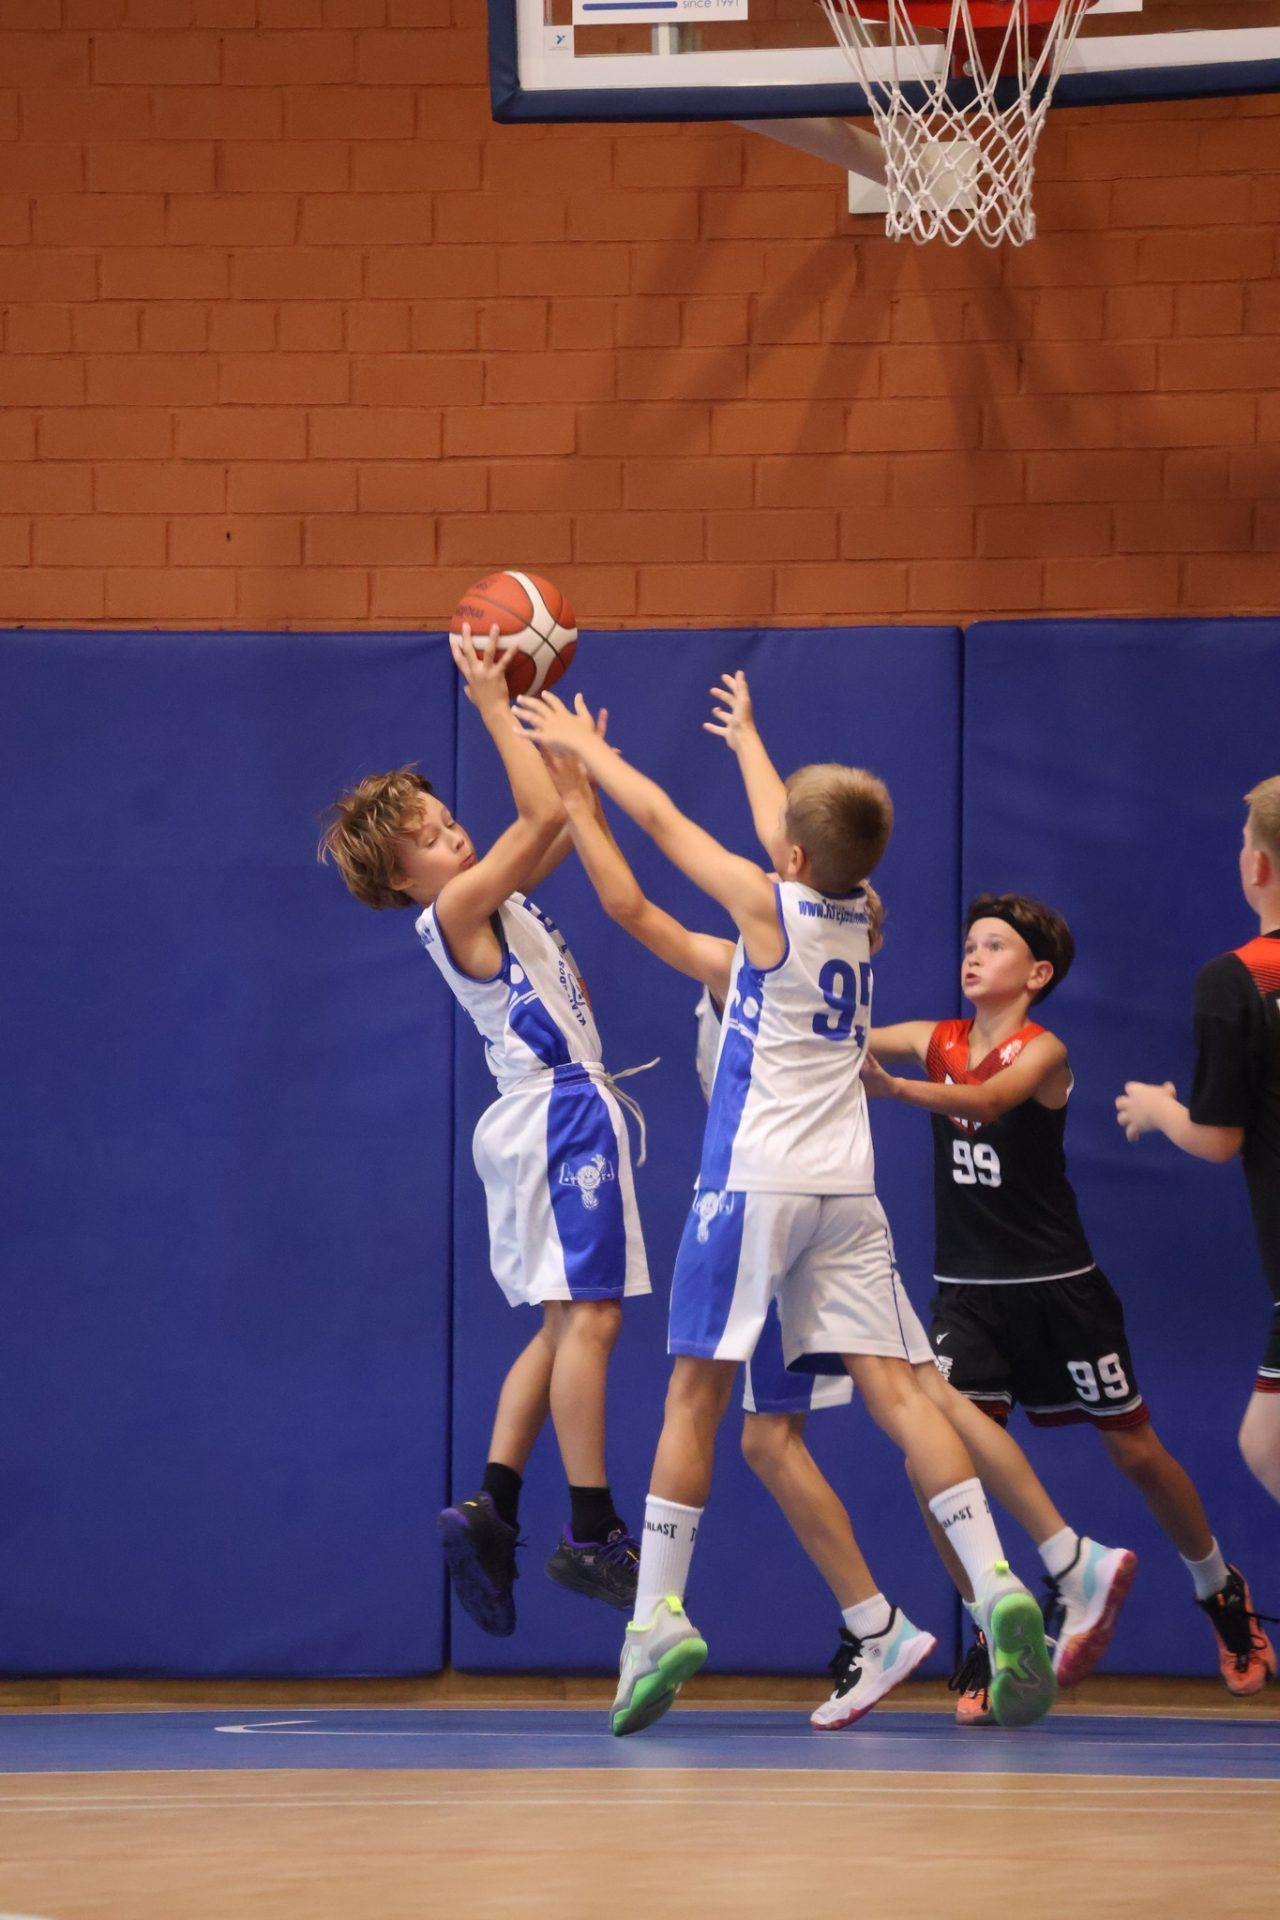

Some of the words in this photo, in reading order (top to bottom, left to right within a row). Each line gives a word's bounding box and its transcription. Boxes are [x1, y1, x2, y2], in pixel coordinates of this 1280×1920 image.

[683, 0, 711, 8] since
[952, 1139, 1002, 1188] 99
[1066, 1352, 1130, 1402] 99
